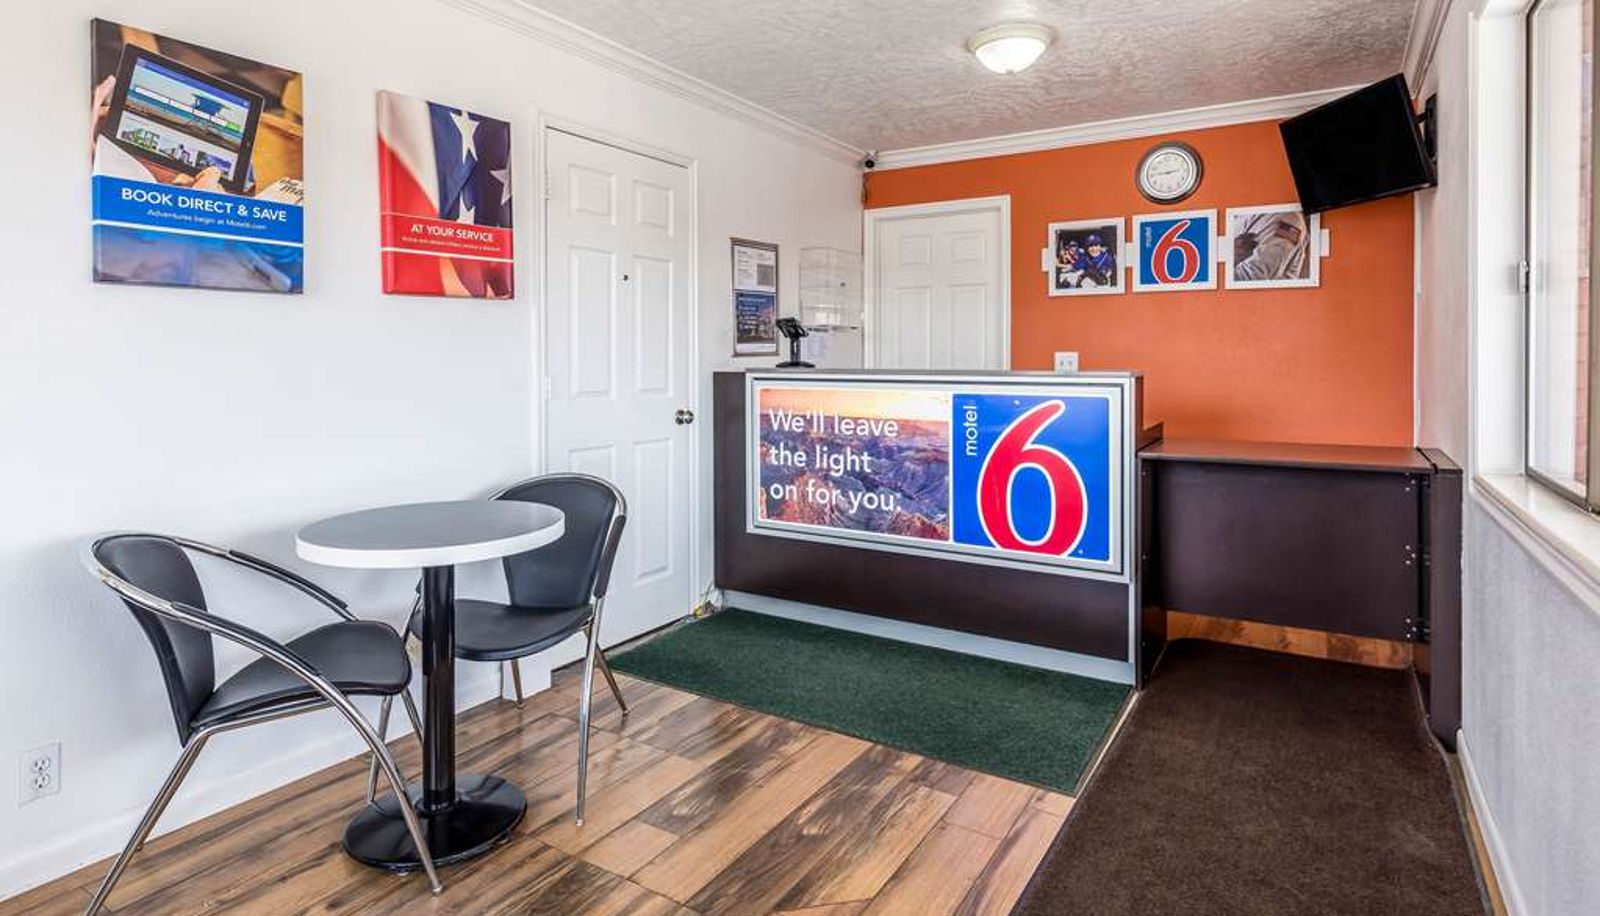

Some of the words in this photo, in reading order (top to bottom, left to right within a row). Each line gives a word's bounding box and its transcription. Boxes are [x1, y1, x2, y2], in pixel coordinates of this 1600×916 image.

[121, 187, 173, 206] BOOK
[178, 195, 233, 214] DIRECT
[237, 204, 249, 217] &
[252, 206, 288, 222] SAVE
[411, 224, 423, 234] AT
[426, 225, 454, 238] YOUR
[456, 229, 494, 243] SERVICE
[1151, 219, 1200, 285] 6
[769, 408, 825, 433] We'll
[834, 411, 899, 437] leave
[769, 442, 807, 467] the
[815, 444, 873, 476] light
[963, 405, 978, 456] motel
[976, 399, 1088, 558] 6
[770, 482, 797, 500] on
[806, 479, 842, 505] for
[849, 489, 902, 514] you.
